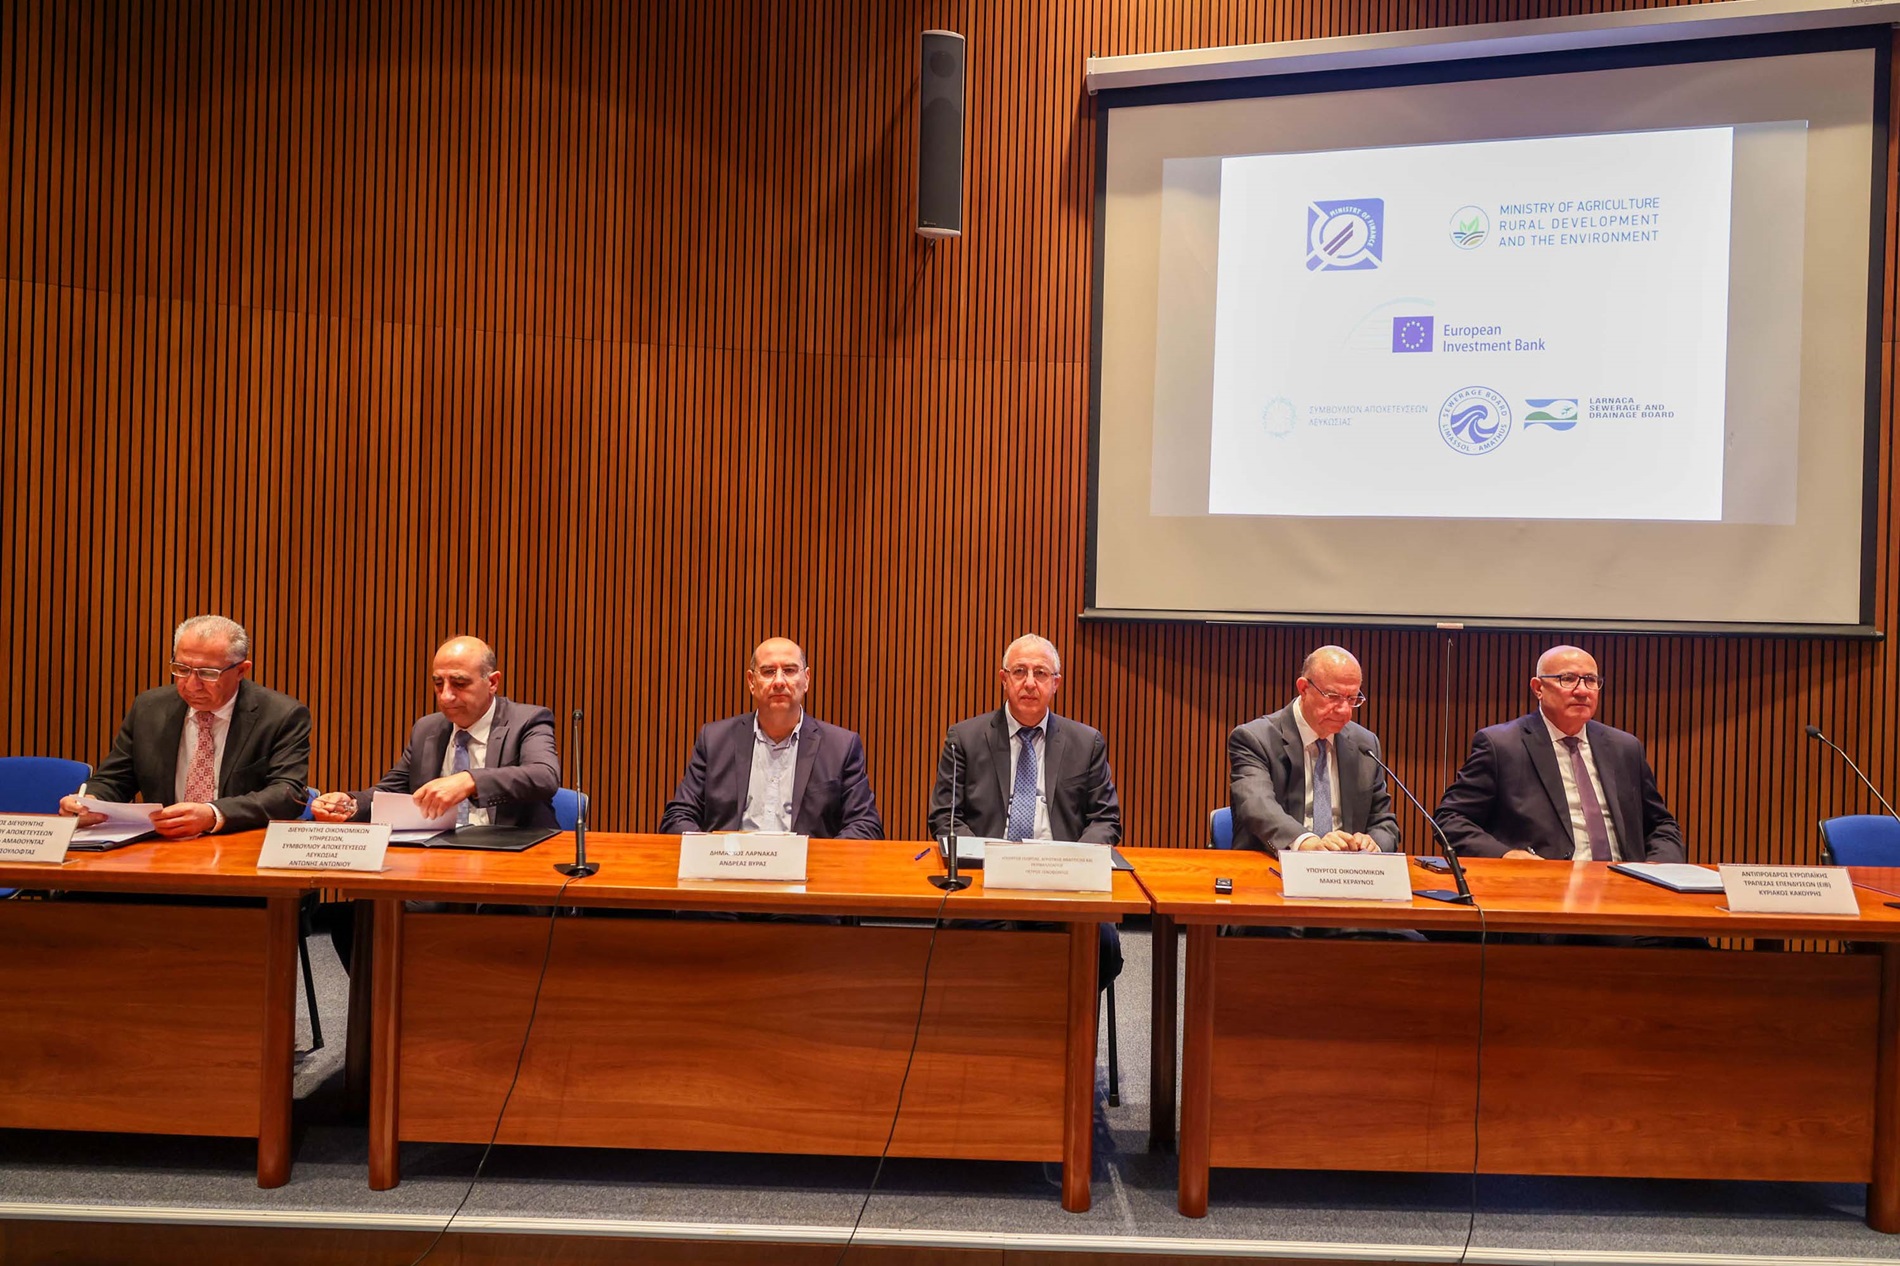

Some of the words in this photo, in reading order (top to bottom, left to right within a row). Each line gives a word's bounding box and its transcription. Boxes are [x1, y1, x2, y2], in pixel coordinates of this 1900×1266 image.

[1500, 203, 1555, 215] MINISTRY
[1558, 202, 1574, 212] OF
[1577, 197, 1660, 212] AGRICULTURE
[1330, 206, 1361, 217] MINISTRY
[1361, 212, 1370, 220] OF
[1367, 219, 1376, 247] FINANCE
[1499, 219, 1545, 231] RURAL
[1551, 214, 1659, 229] DEVELOPMENT
[1499, 236, 1525, 247] AND
[1531, 235, 1555, 245] THE
[1560, 230, 1659, 245] ENVIRONMENT
[1444, 324, 1501, 338] European
[1443, 340, 1511, 352] Investment
[1515, 338, 1545, 351] Bank
[1443, 389, 1482, 418] SEWERAGE
[1485, 391, 1507, 416] BOARD
[1443, 424, 1470, 451] LIMASSOL
[1479, 424, 1506, 451] AMATHUS
